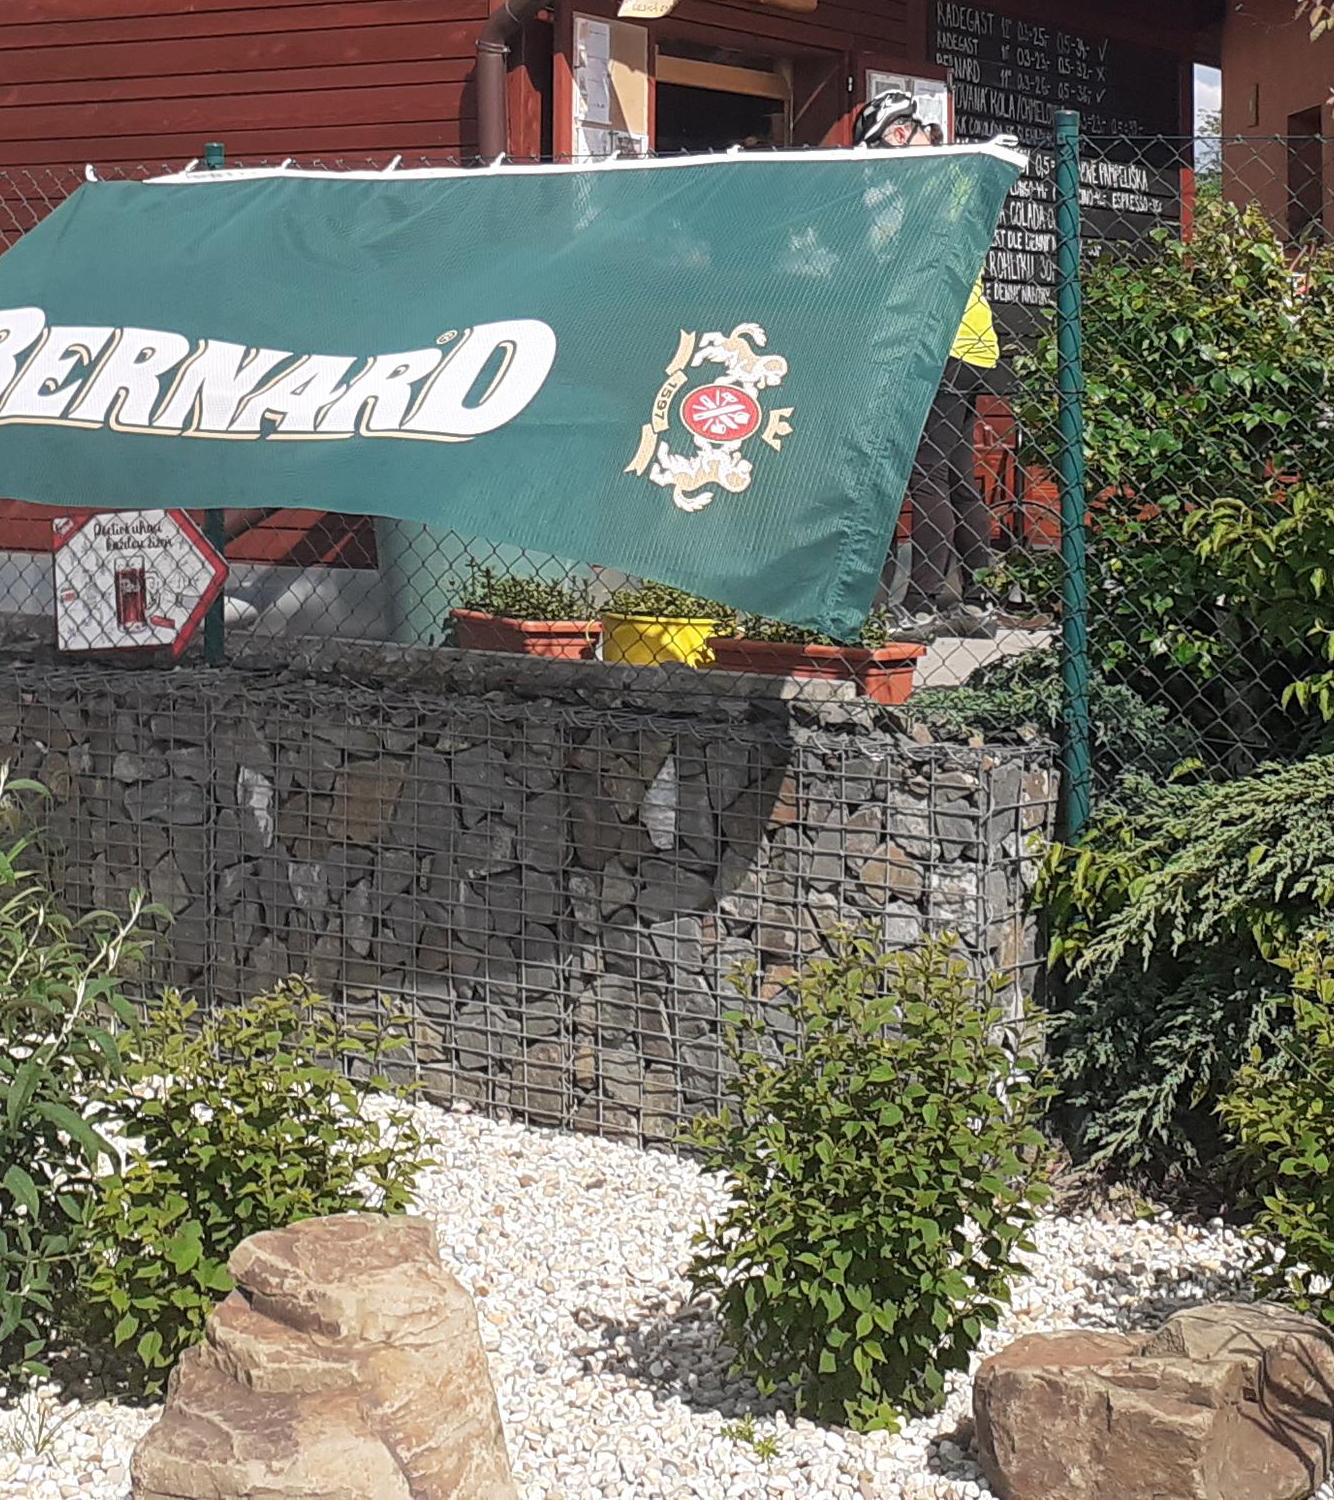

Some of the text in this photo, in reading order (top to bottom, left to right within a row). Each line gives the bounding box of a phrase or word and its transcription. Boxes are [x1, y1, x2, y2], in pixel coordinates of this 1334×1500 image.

[937, 1, 994, 36] RADEGAST
[937, 31, 979, 56] RADEGAST
[654, 381, 678, 422] 1597
